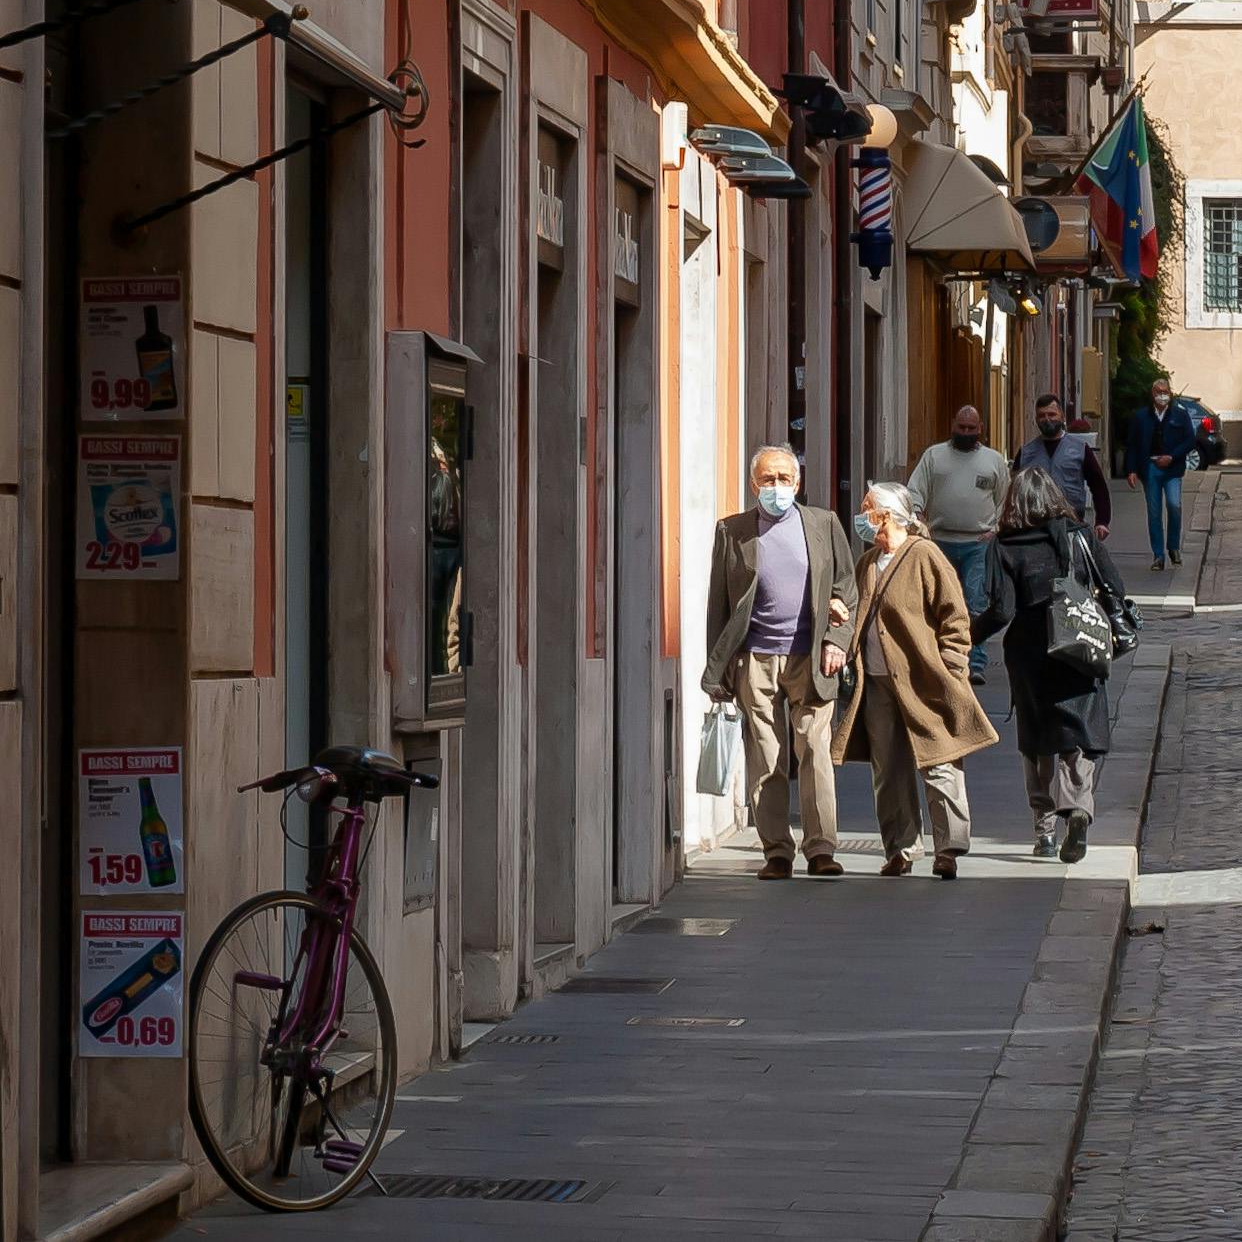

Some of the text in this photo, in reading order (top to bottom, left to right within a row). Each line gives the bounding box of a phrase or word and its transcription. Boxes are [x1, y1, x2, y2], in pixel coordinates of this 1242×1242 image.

[90, 378, 151, 410] 9,99
[86, 541, 140, 571] 2,29
[88, 755, 174, 770] BASSI SEMPRE
[88, 854, 142, 886] 1,59
[89, 917, 177, 931] BASSI SEMPRE
[117, 1016, 175, 1047] 0,69
